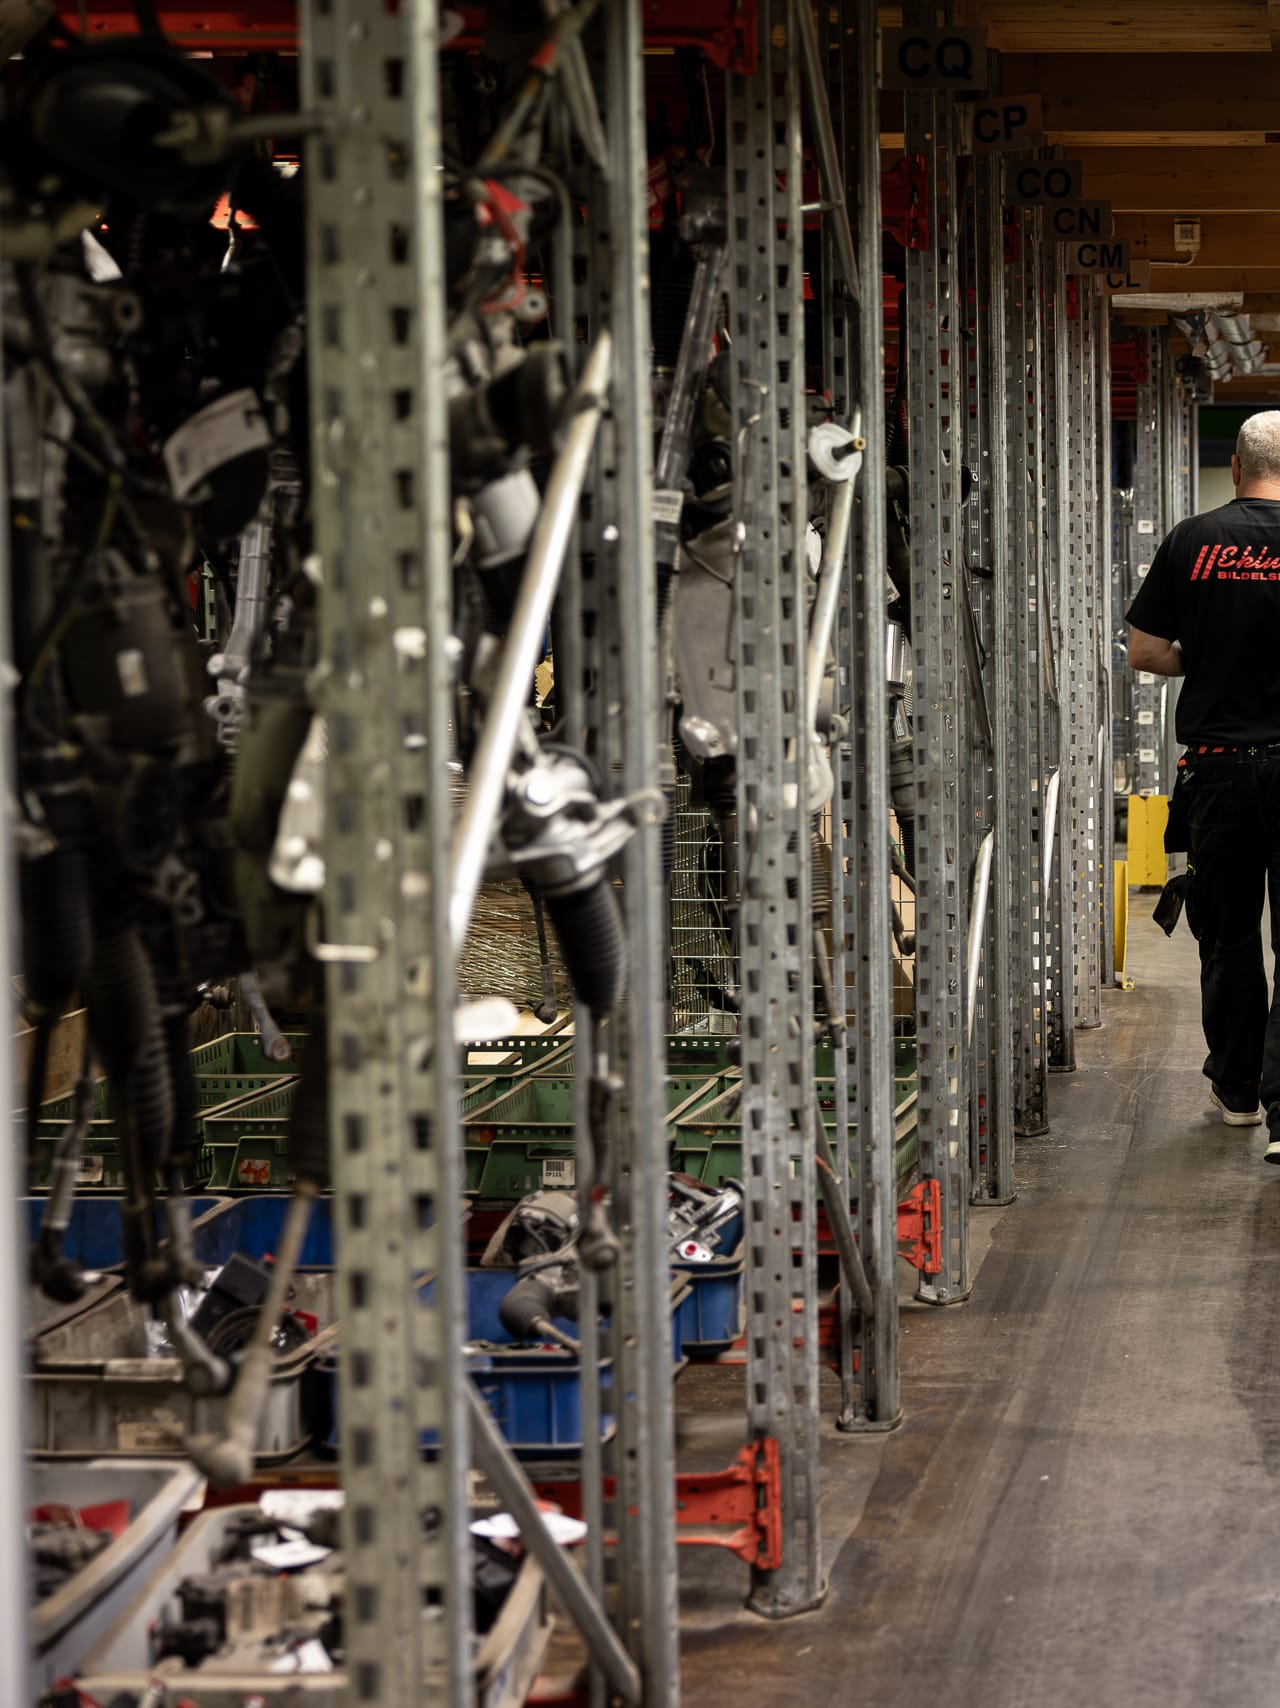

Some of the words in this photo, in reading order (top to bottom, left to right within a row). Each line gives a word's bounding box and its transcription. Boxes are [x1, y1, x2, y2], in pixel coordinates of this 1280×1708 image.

[898, 37, 973, 81] CQ
[973, 105, 1028, 143] CP
[1015, 168, 1072, 199] CO
[1053, 208, 1101, 235] CN
[1077, 244, 1123, 268] CM
